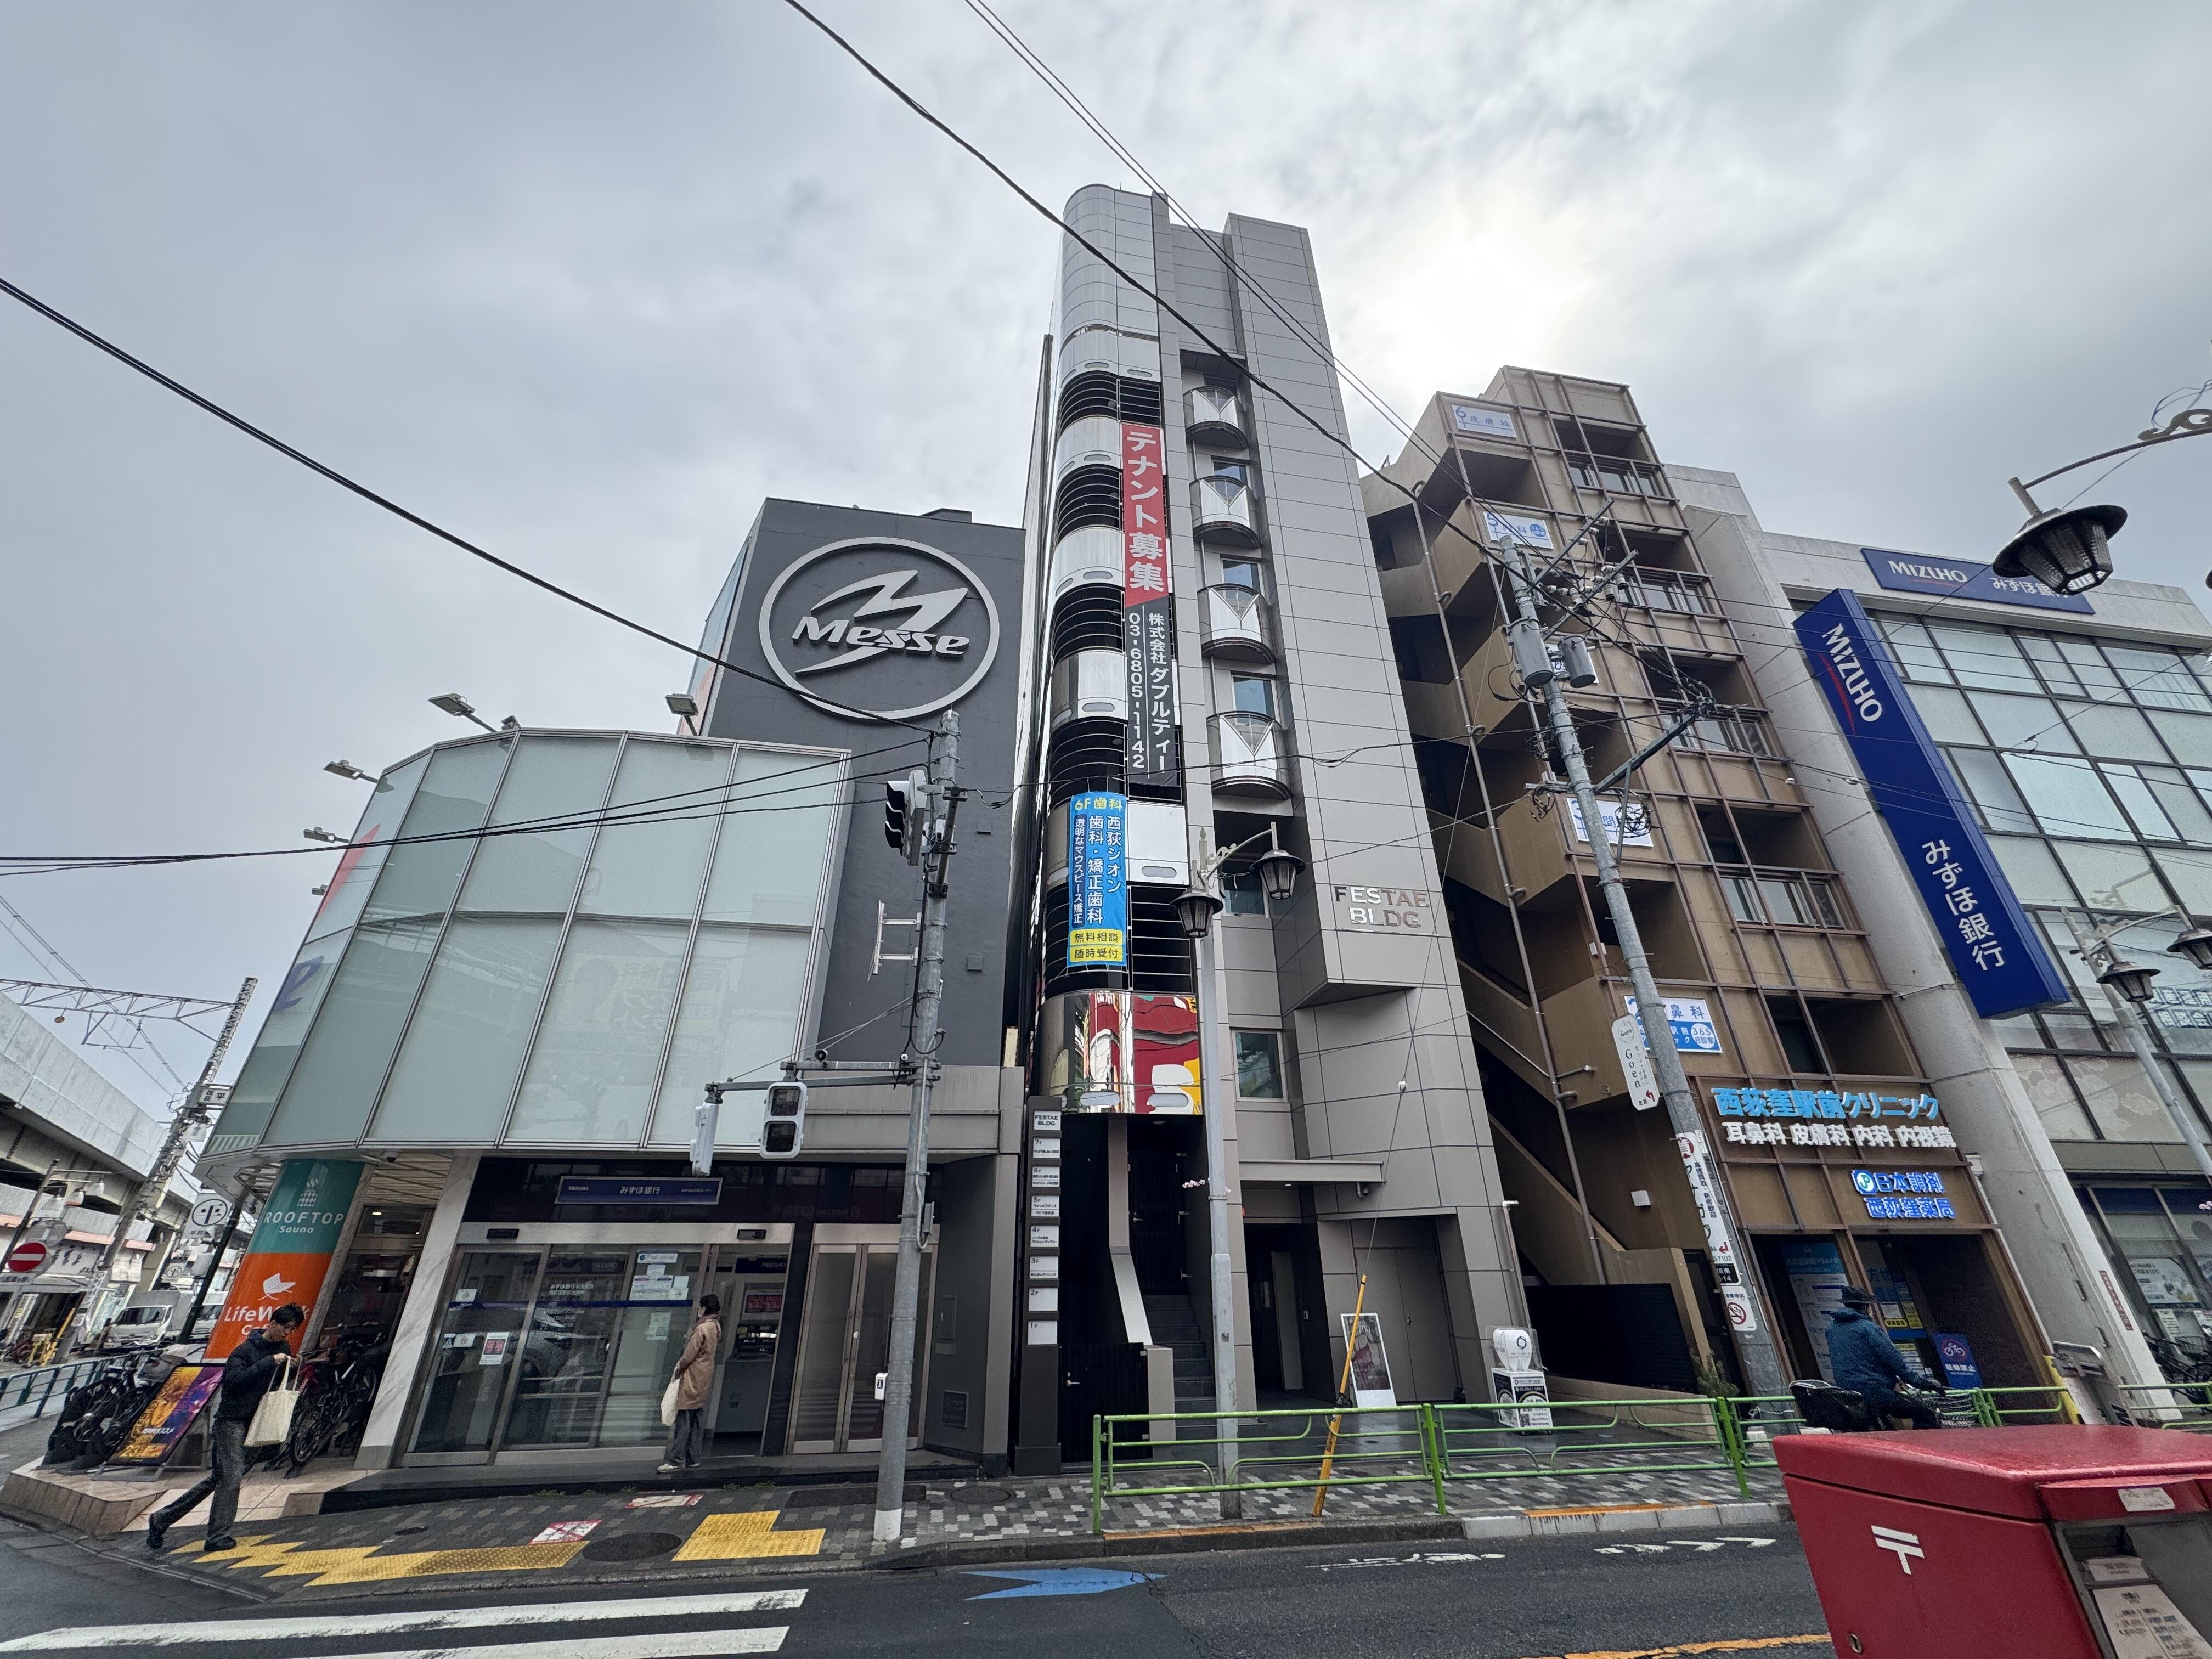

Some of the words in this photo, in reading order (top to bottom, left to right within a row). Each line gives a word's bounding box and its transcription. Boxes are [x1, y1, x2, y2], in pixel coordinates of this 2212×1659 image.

[1470, 415, 1509, 427] 皮膚科
[1126, 431, 1165, 593] テナント募集
[1887, 560, 1968, 583] MIZUHO
[1989, 578, 2068, 599] みずほ銀
[791, 616, 970, 656] Messe
[1821, 623, 1883, 723] MIZUHO
[1129, 612, 1146, 769] 03-6805-1142
[1148, 612, 1171, 774] 株式会社ダブルティー
[1106, 815, 1121, 893] 西荻シオン
[1073, 817, 1086, 924] 透明なマウスピース矯正
[1087, 815, 1104, 924] 歯科・矯正歯科
[1334, 886, 1430, 908] FESTAE
[1922, 838, 2005, 971] みずほ銀行
[1348, 907, 1421, 928] BLDG
[1074, 932, 1118, 943] 無料相談
[1074, 949, 1118, 960] 随時受付
[1692, 1028, 1711, 1036] 365
[1625, 1048, 1641, 1088] Goen
[1711, 1088, 1939, 1120] 西荻窪駅前クリニック
[1722, 1121, 1787, 1146] 耳鼻科
[1790, 1122, 1851, 1147] 皮膚科
[1852, 1124, 1895, 1147] 内科
[1897, 1125, 1957, 1148] 内視鏡
[619, 1186, 661, 1195] みずほ銀行
[1873, 1172, 1945, 1193] 日本調剤
[263, 1211, 344, 1225] ROOFTOP
[1864, 1197, 1957, 1219] 西荻窪薬局
[279, 1225, 314, 1233] Sauna
